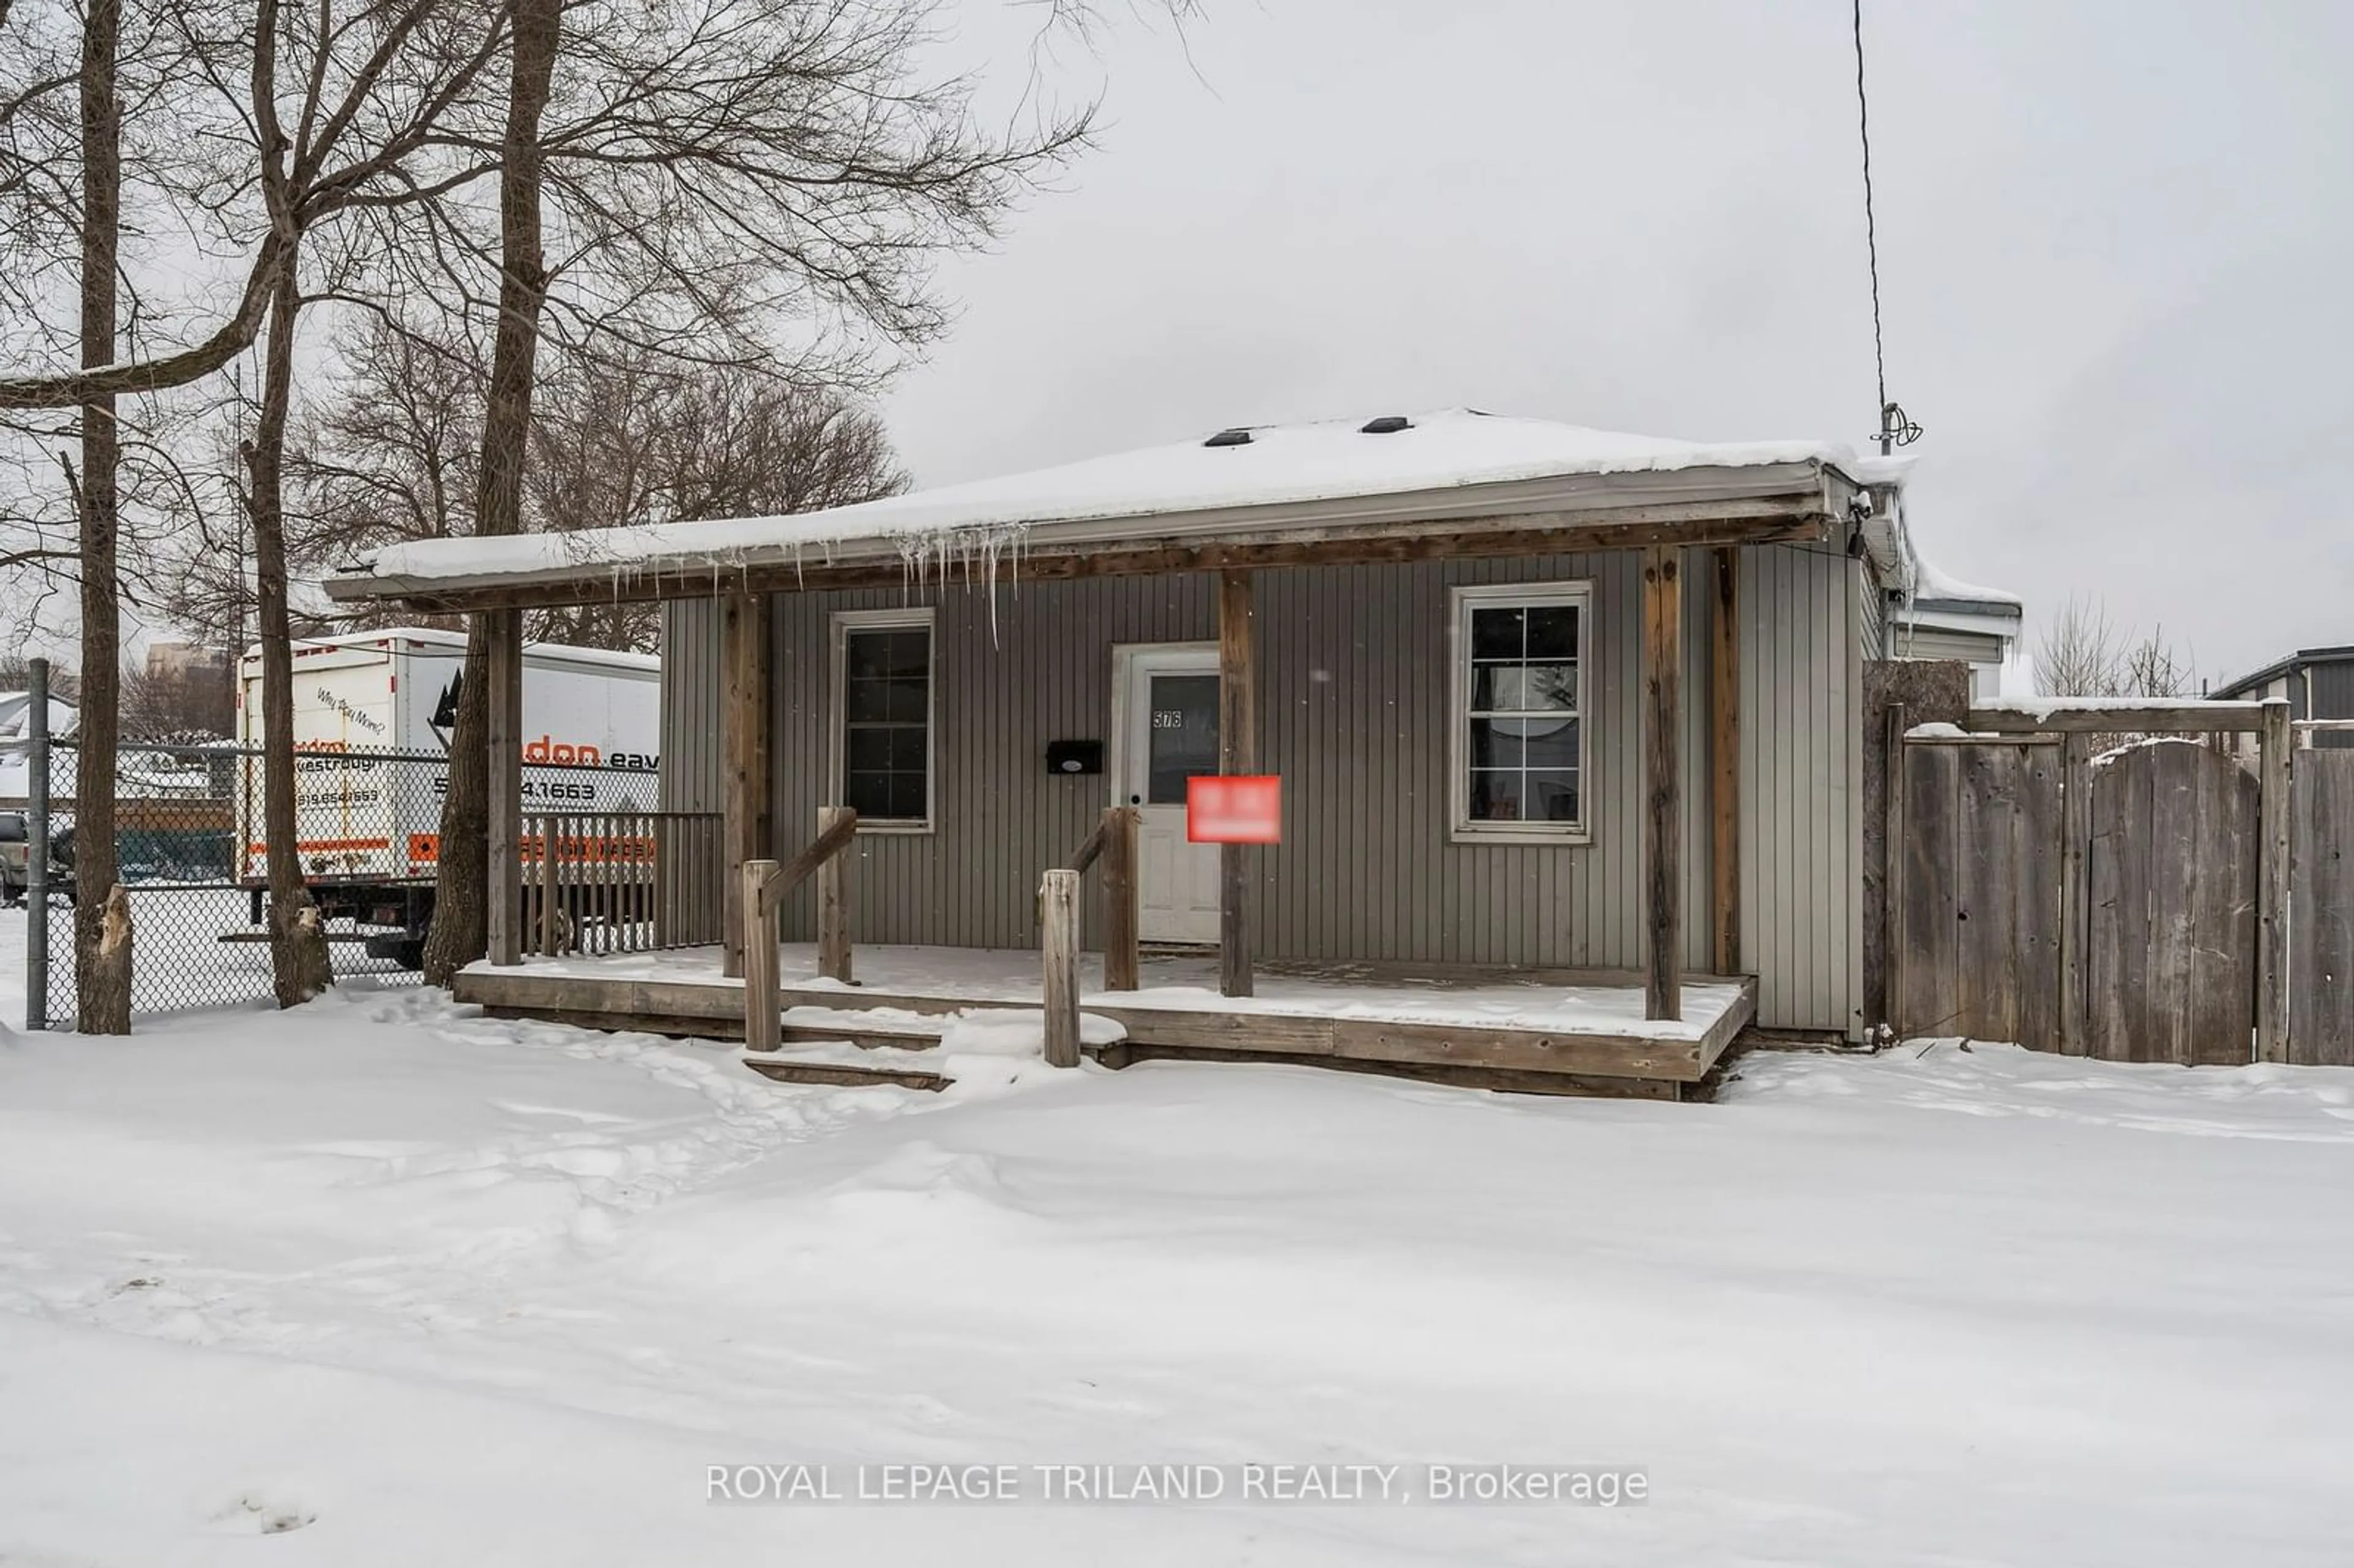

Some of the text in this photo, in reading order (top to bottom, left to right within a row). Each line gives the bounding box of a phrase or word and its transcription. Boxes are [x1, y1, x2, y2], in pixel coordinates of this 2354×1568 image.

[317, 687, 386, 736] Why Pay More?
[521, 735, 660, 769] don eav
[521, 782, 595, 799] 4.1663
